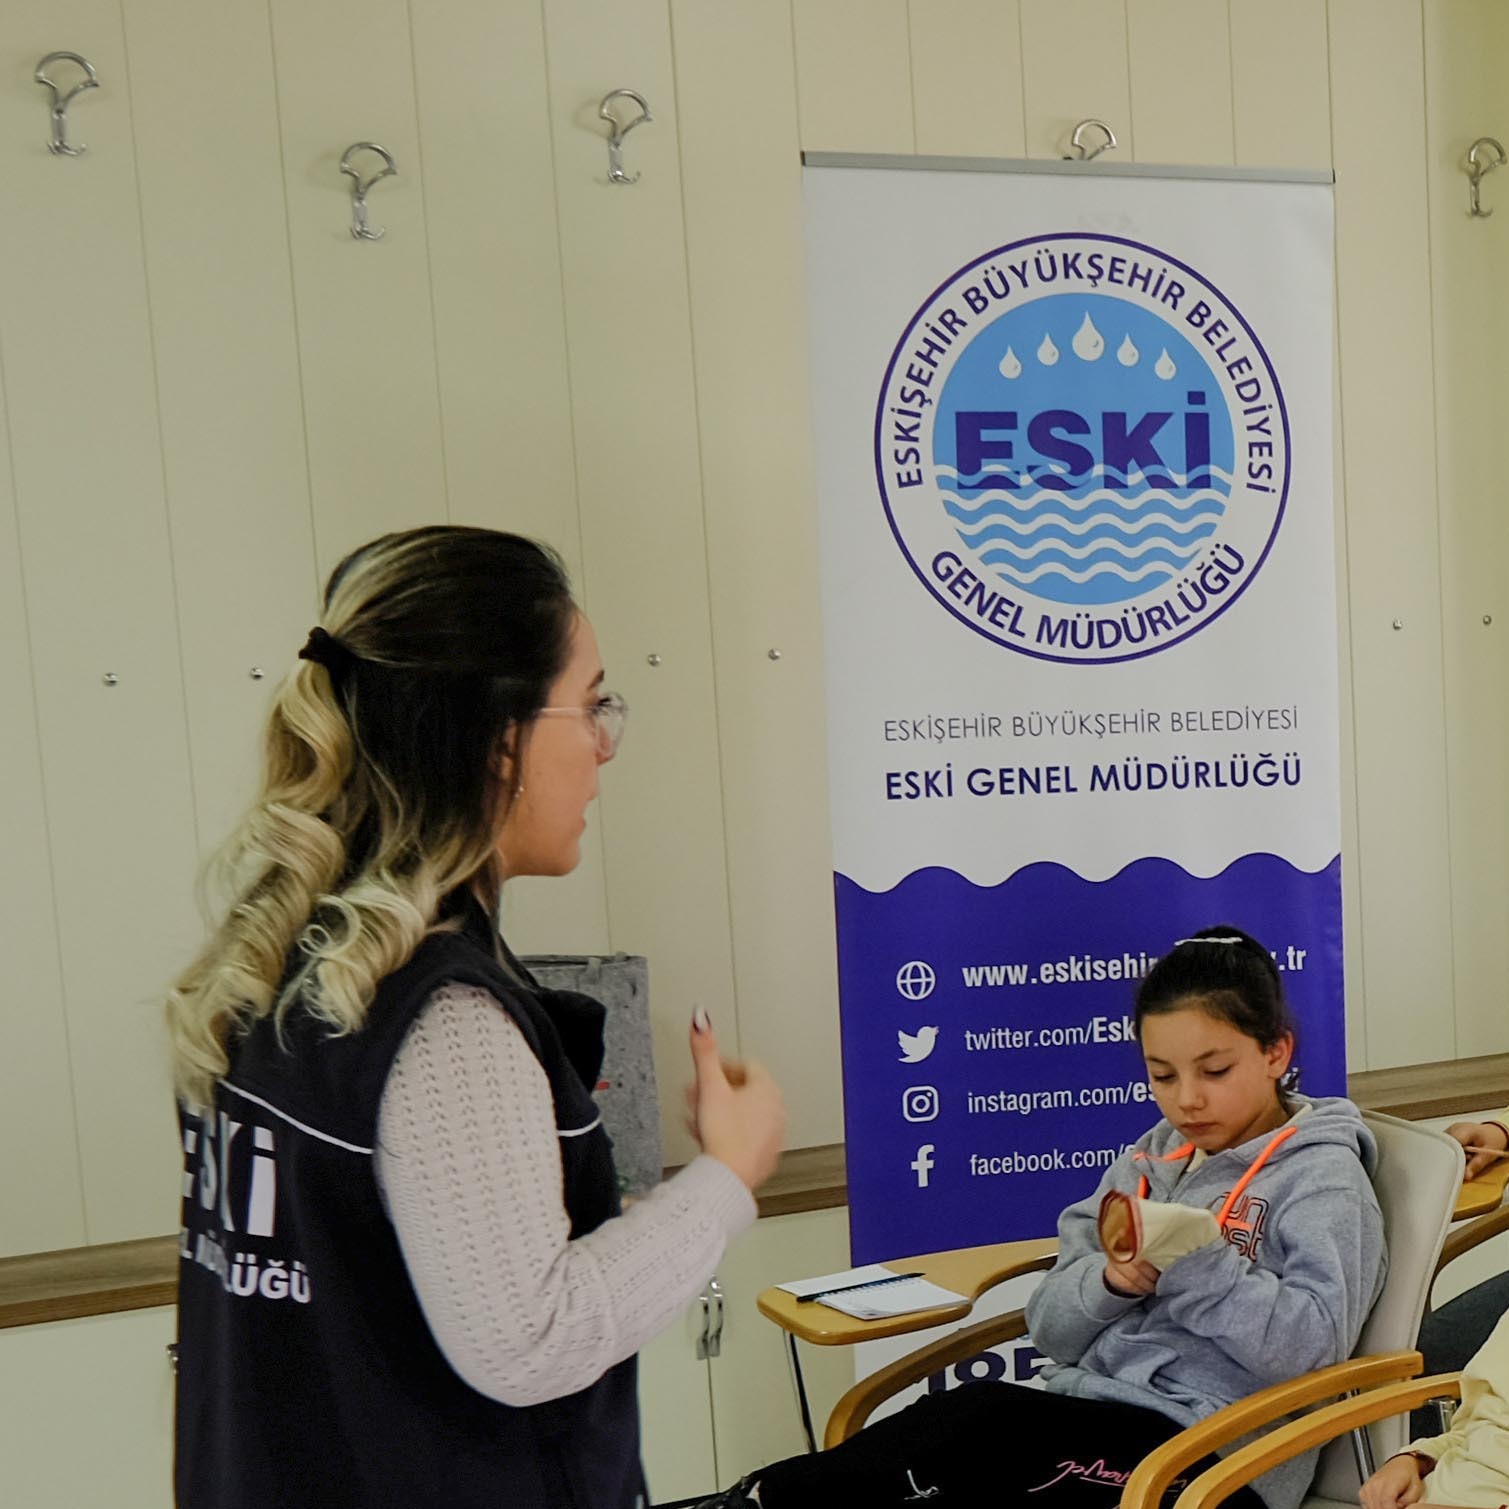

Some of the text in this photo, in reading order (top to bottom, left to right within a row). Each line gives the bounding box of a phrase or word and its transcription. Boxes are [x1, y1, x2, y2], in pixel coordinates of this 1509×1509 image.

[892, 248, 1278, 496] ESKİŞEHİR BÜYÜKŞEHİR BELEDİYESİ
[954, 390, 1213, 491] ESKİ
[930, 541, 1247, 650] GENEL MÜDÜRLÜĞÜ
[884, 705, 1299, 743] ESKİŞEHİR BÜYÜKŞEHİR BELEDİYESİ
[886, 752, 1301, 801] ESKİ GENEL MÜDÜRLÜĞÜ
